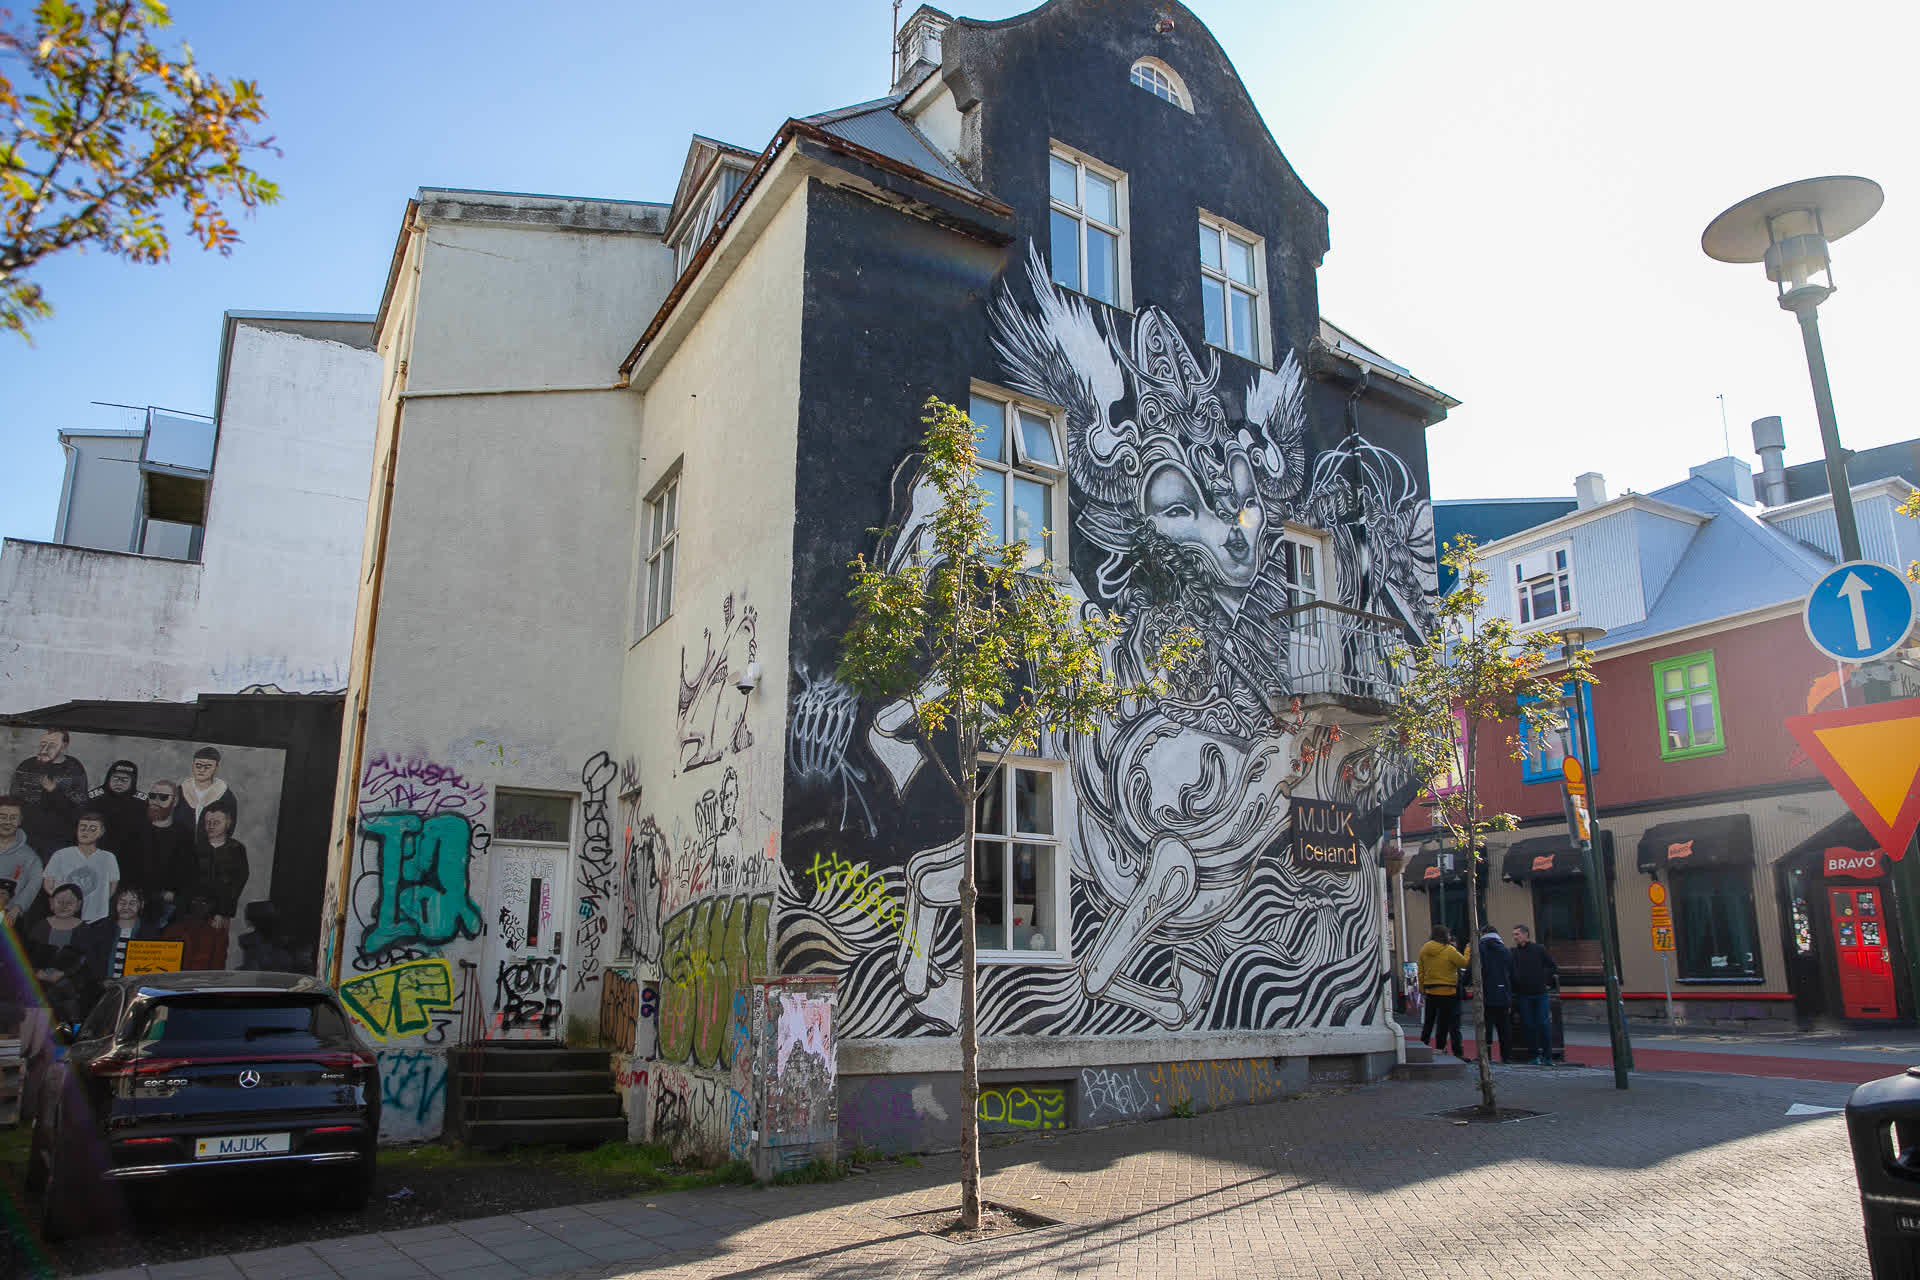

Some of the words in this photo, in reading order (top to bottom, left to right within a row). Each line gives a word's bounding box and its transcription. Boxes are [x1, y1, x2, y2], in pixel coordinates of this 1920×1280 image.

[1298, 804, 1354, 837] MJÚK
[1299, 838, 1357, 865] Iceland
[1828, 851, 1876, 871] BRAVÓ
[219, 1136, 268, 1154] MJUK
